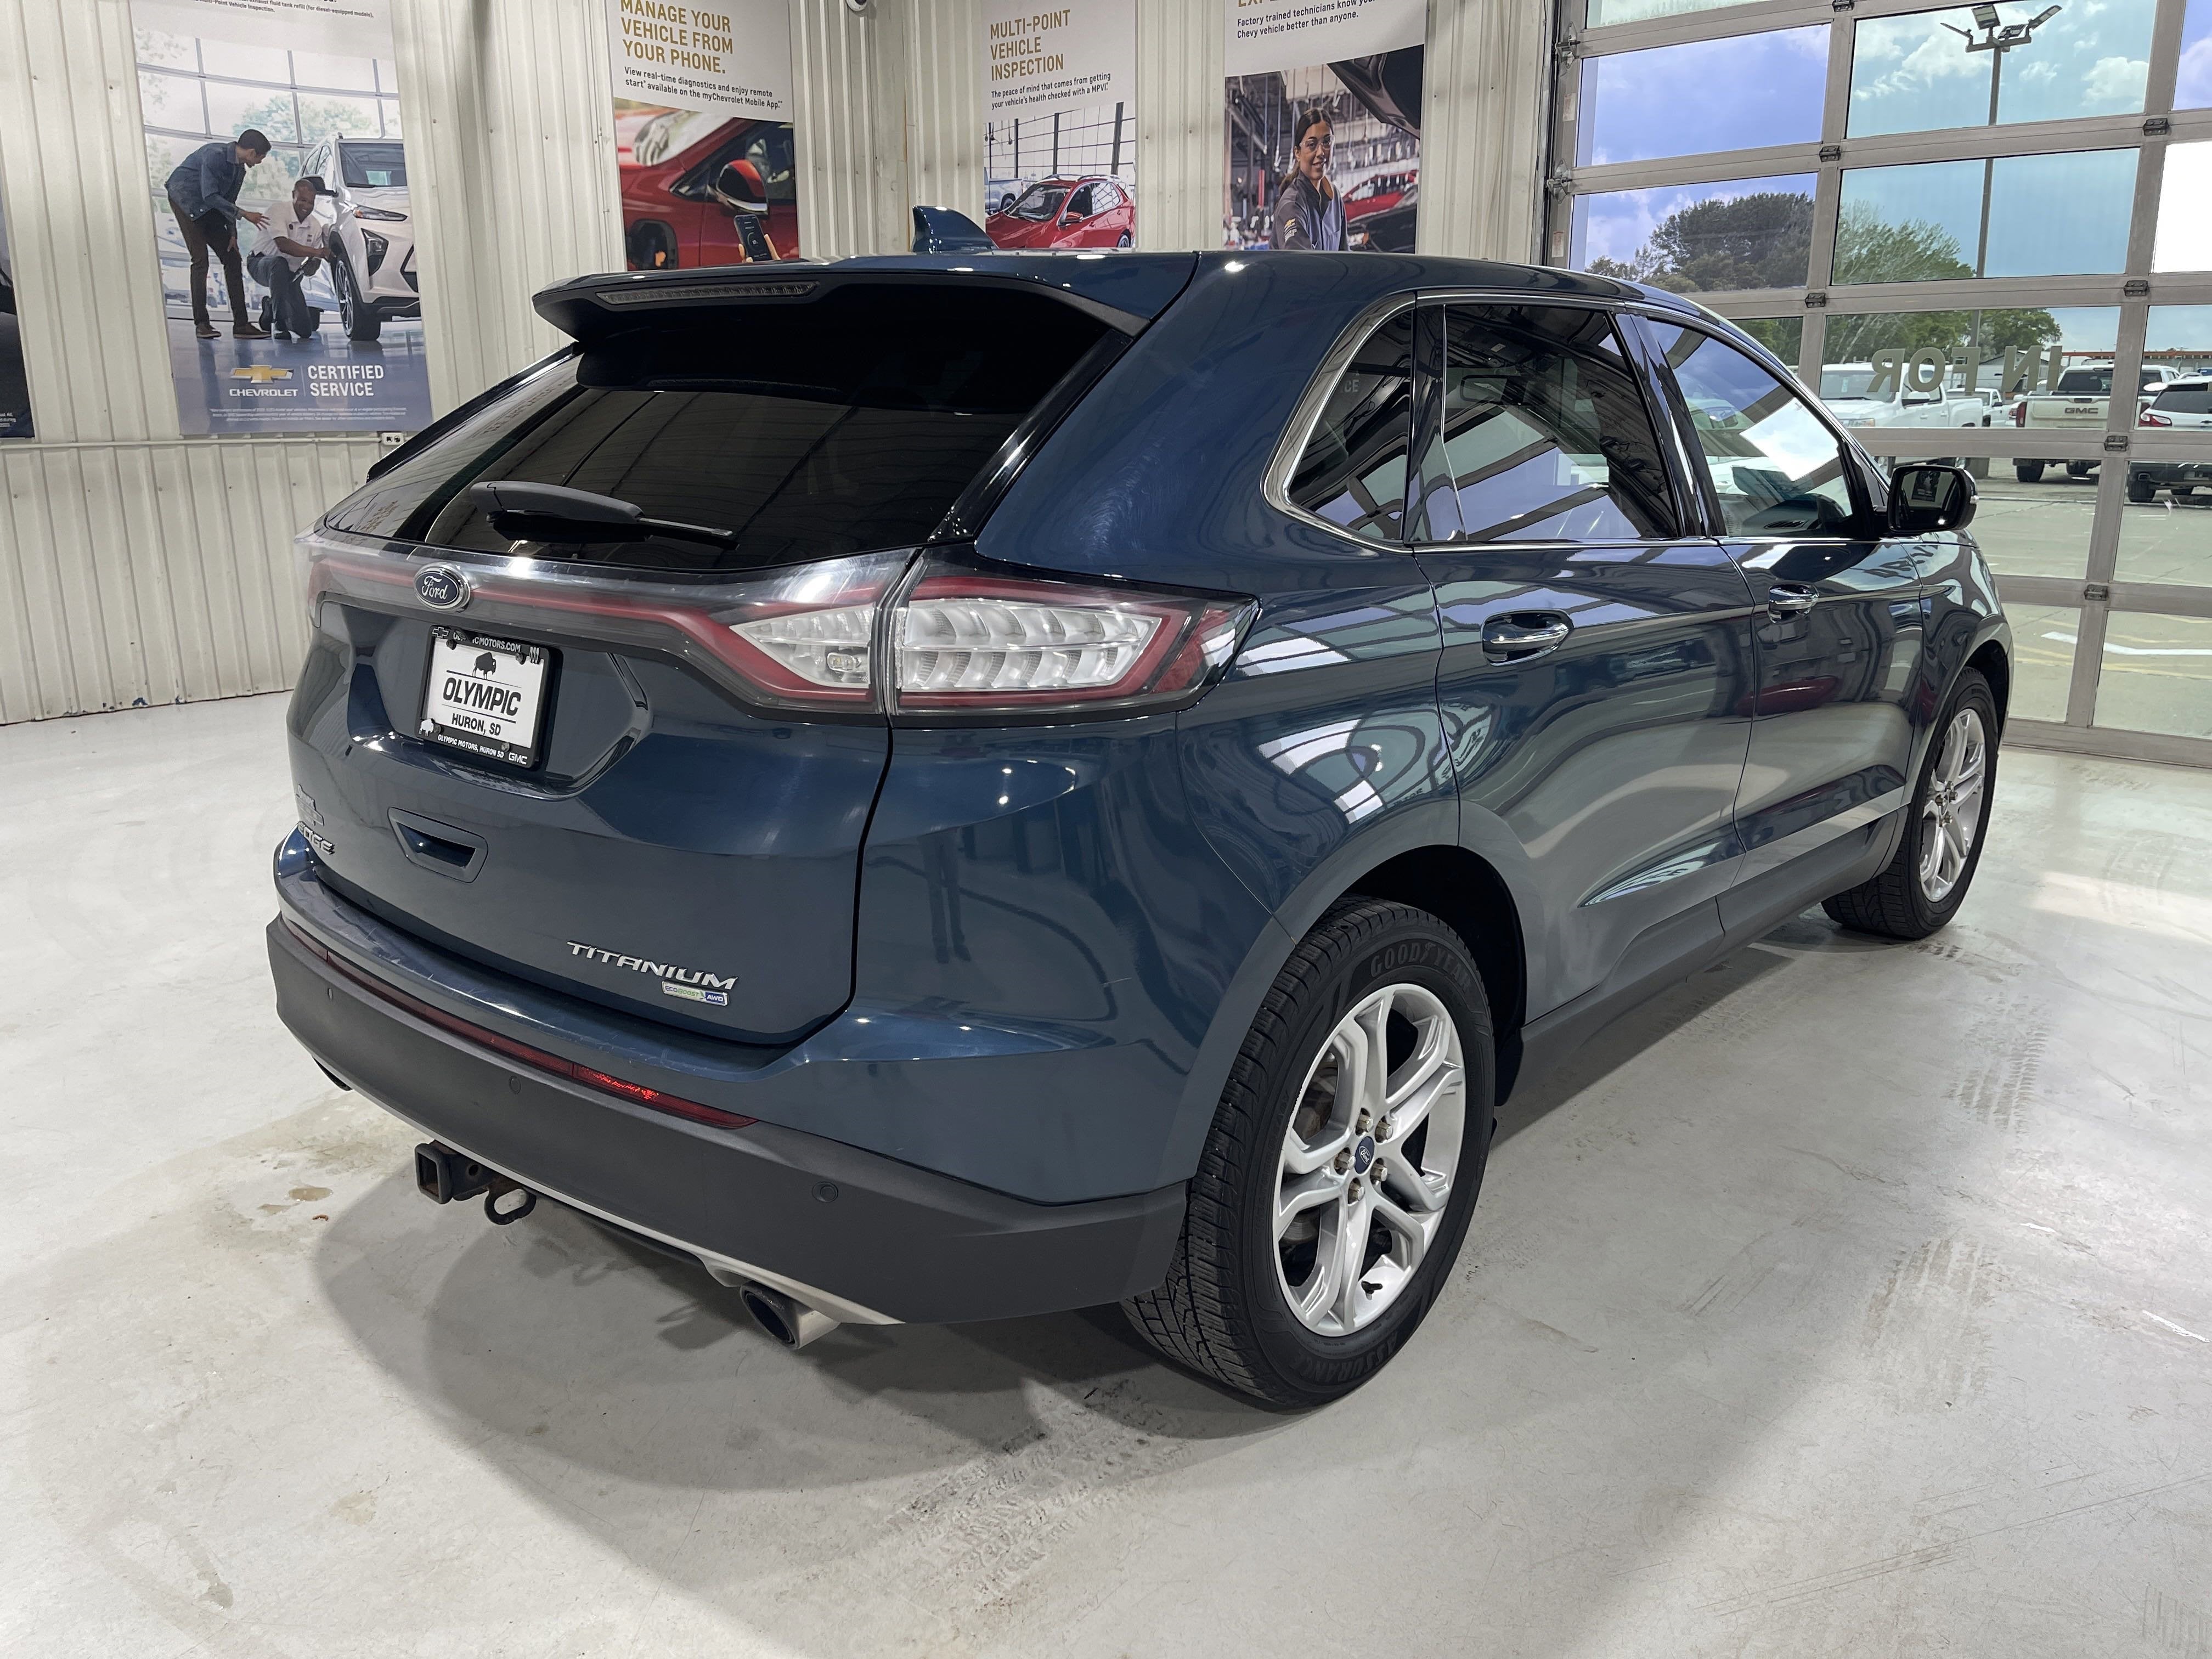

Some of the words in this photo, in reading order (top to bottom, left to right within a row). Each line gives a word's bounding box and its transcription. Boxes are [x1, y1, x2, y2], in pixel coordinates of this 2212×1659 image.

[620, 0, 687, 25] MANAGE
[691, 10, 731, 33] YOUR
[990, 9, 1070, 40] MULTI-POINT
[1237, 17, 1264, 27] Factory
[1266, 10, 1291, 22] trained
[1293, 3, 1335, 18] technicians
[1337, 0, 1357, 9] know
[1237, 29, 1258, 38] Chevy
[1260, 24, 1284, 35] vehicle
[1286, 20, 1309, 31] better
[1311, 16, 1328, 27] than
[1329, 11, 1359, 23] anyone.
[621, 17, 688, 47] VEHICLE
[693, 31, 733, 54] FROM
[990, 36, 1041, 60] VEHICLE
[622, 39, 666, 64] YOUR
[671, 48, 726, 74] PHONE.
[991, 54, 1064, 81] INSPECTION
[624, 66, 642, 77] View
[644, 72, 676, 83] real-time
[678, 76, 716, 90] diagnostics
[731, 86, 748, 96] enjoy
[1002, 88, 1018, 98] peace
[1019, 85, 1025, 94] of
[1026, 83, 1040, 93] mind
[1041, 82, 1053, 91] that
[1054, 80, 1072, 88] comes
[1074, 77, 1087, 85] from
[1090, 72, 1111, 84] getting
[647, 83, 678, 94] available
[690, 89, 701, 98] the
[702, 93, 743, 104] myChevrolet
[745, 97, 765, 106] Mobile
[991, 100, 1003, 110] your
[1029, 93, 1046, 103] health
[1048, 89, 1071, 100] checked
[1073, 87, 1085, 96] with
[307, 365, 384, 380] CERTIFIED
[229, 388, 298, 397] CHEVROLET
[310, 382, 374, 397] SERVICE
[421, 575, 448, 601] Ford
[443, 677, 521, 716] OLYMPIC
[452, 713, 486, 735] HURON,
[489, 723, 501, 736] SD
[438, 734, 458, 746] OLYMPIC
[458, 740, 478, 752] MOTORS,
[479, 746, 497, 755] HURON
[497, 750, 504, 758] SD
[509, 752, 528, 765] GMC
[298, 821, 336, 855] EDGE
[567, 940, 738, 990] TITANIUM
[1370, 942, 1471, 992] GOODYEAR
[665, 985, 699, 997] ECOBOOST
[707, 994, 724, 1002] AWD
[1361, 1149, 1370, 1163] Ford
